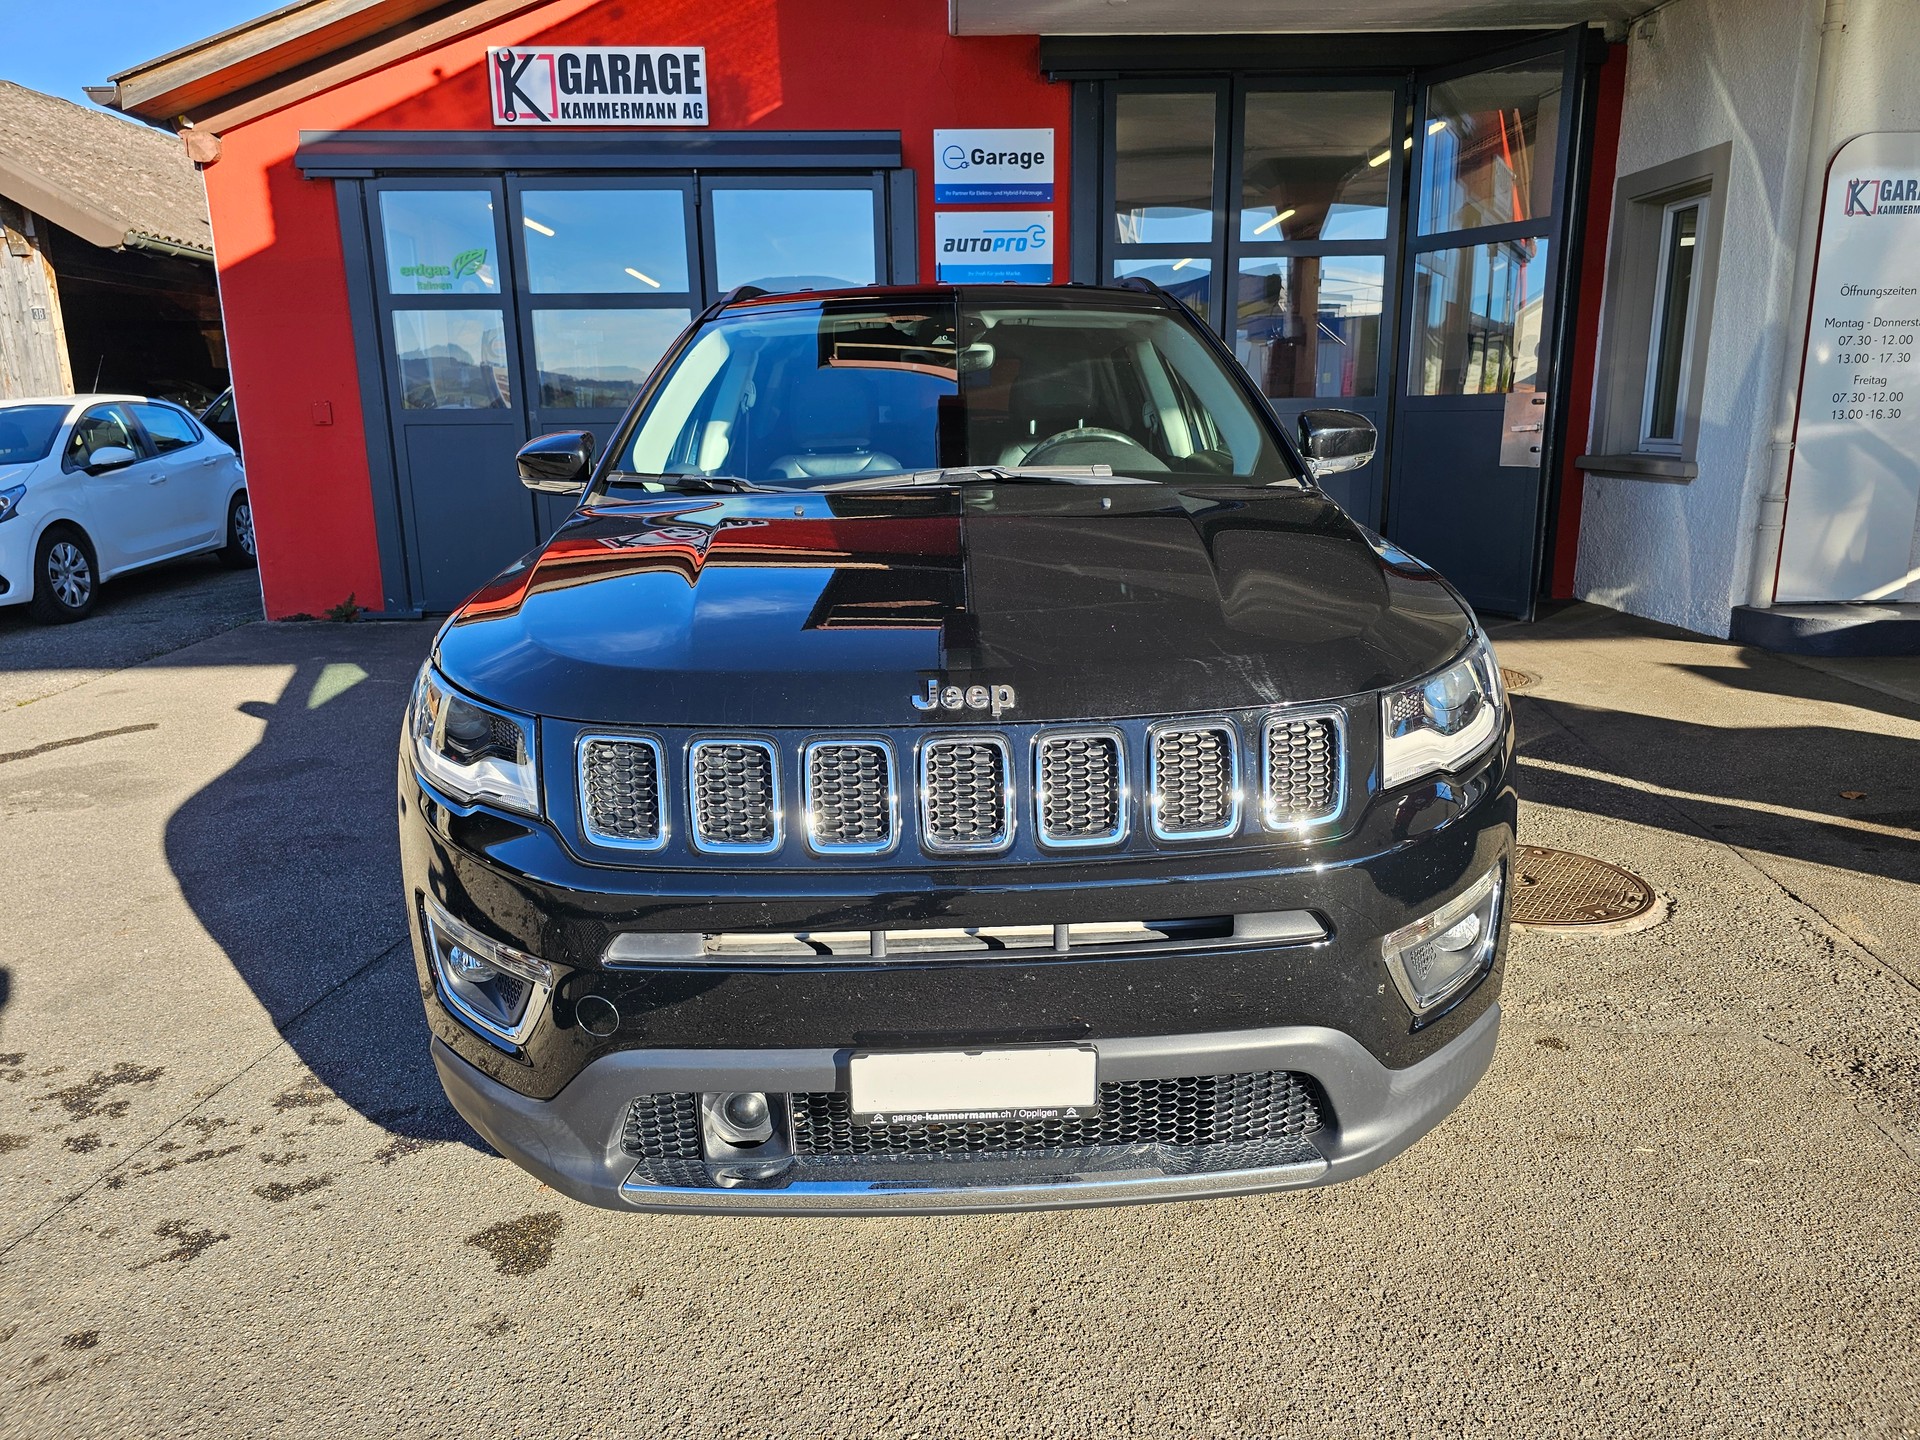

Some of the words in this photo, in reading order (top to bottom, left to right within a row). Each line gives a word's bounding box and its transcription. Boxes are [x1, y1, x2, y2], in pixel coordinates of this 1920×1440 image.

[557, 53, 702, 95] GARAGE
[560, 102, 677, 119] KAMMERMANN
[682, 102, 703, 119] AG
[1840, 283, 1917, 299] Öffnungszeiten
[1824, 317, 1864, 331] Montag
[1838, 335, 1872, 346] 07.30
[1882, 334, 1914, 345] 12.00
[1837, 353, 1869, 364] 13.00
[1880, 352, 1911, 363] 17.30
[1853, 374, 1887, 388] Freitag
[1832, 392, 1866, 403] 07.30
[1831, 408, 1864, 420] 13.00
[911, 679, 1015, 717] Jeep
[892, 1111, 1011, 1123] garage-kammermann.ch
